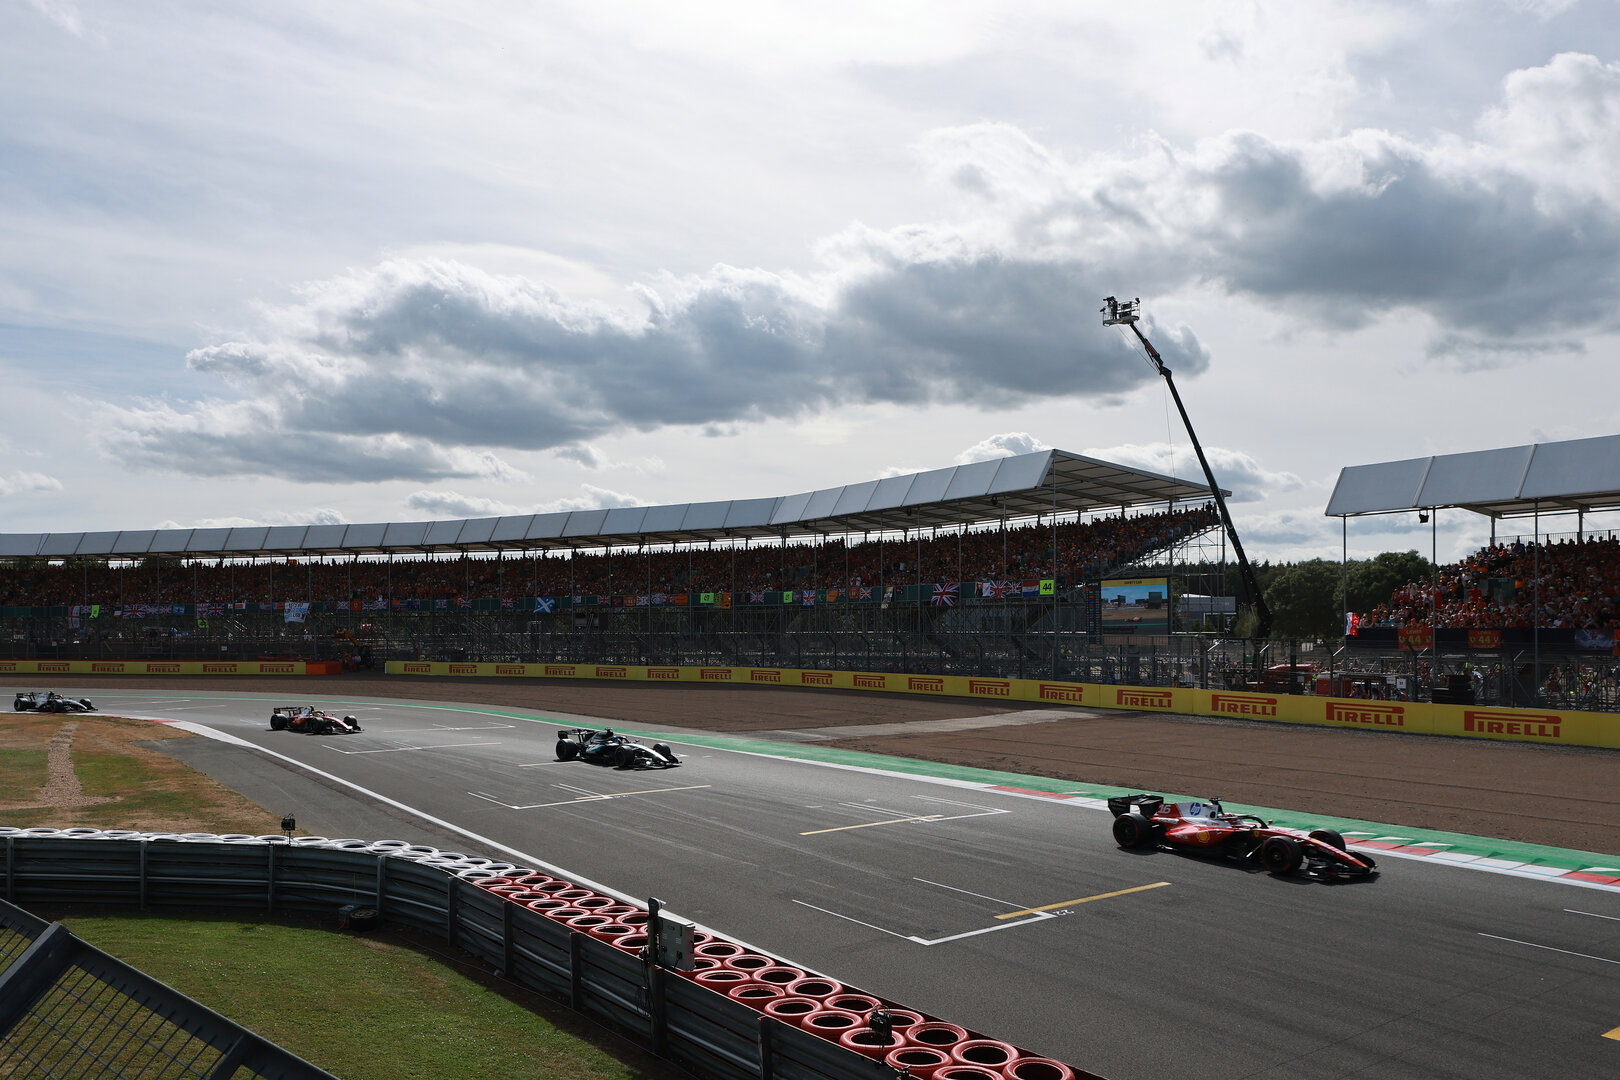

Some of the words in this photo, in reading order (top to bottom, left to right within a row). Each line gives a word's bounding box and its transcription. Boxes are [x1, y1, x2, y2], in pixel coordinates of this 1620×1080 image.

[1043, 583, 1052, 591] 44
[37, 663, 70, 672] PIRELLI
[92, 663, 125, 672] PIRELLI
[146, 663, 180, 673] PIRELLI
[203, 664, 237, 673] PIRELLI
[260, 664, 294, 673] PIRELLI
[403, 663, 431, 673] PIRELLI
[449, 664, 478, 674] PIRELLI
[496, 664, 525, 675] PIRELLI
[544, 665, 576, 676] PIRELLI
[595, 666, 627, 678] PIRELLI
[647, 667, 679, 679] PIRELLI
[700, 668, 732, 680] PIRELLI
[750, 669, 781, 682] PIRELLI
[801, 671, 833, 685] PIRELLI
[853, 674, 886, 689] PIRELLI
[908, 677, 944, 692] PIRELLI
[969, 680, 1011, 696] PIRELLI
[1039, 684, 1083, 702] PIRELLI
[1116, 689, 1173, 708] PIRELLI
[1211, 694, 1278, 716] PIRELLI
[1326, 701, 1405, 726] PIRELLI
[1463, 710, 1562, 738] PIRELLI
[1158, 804, 1172, 814] 16
